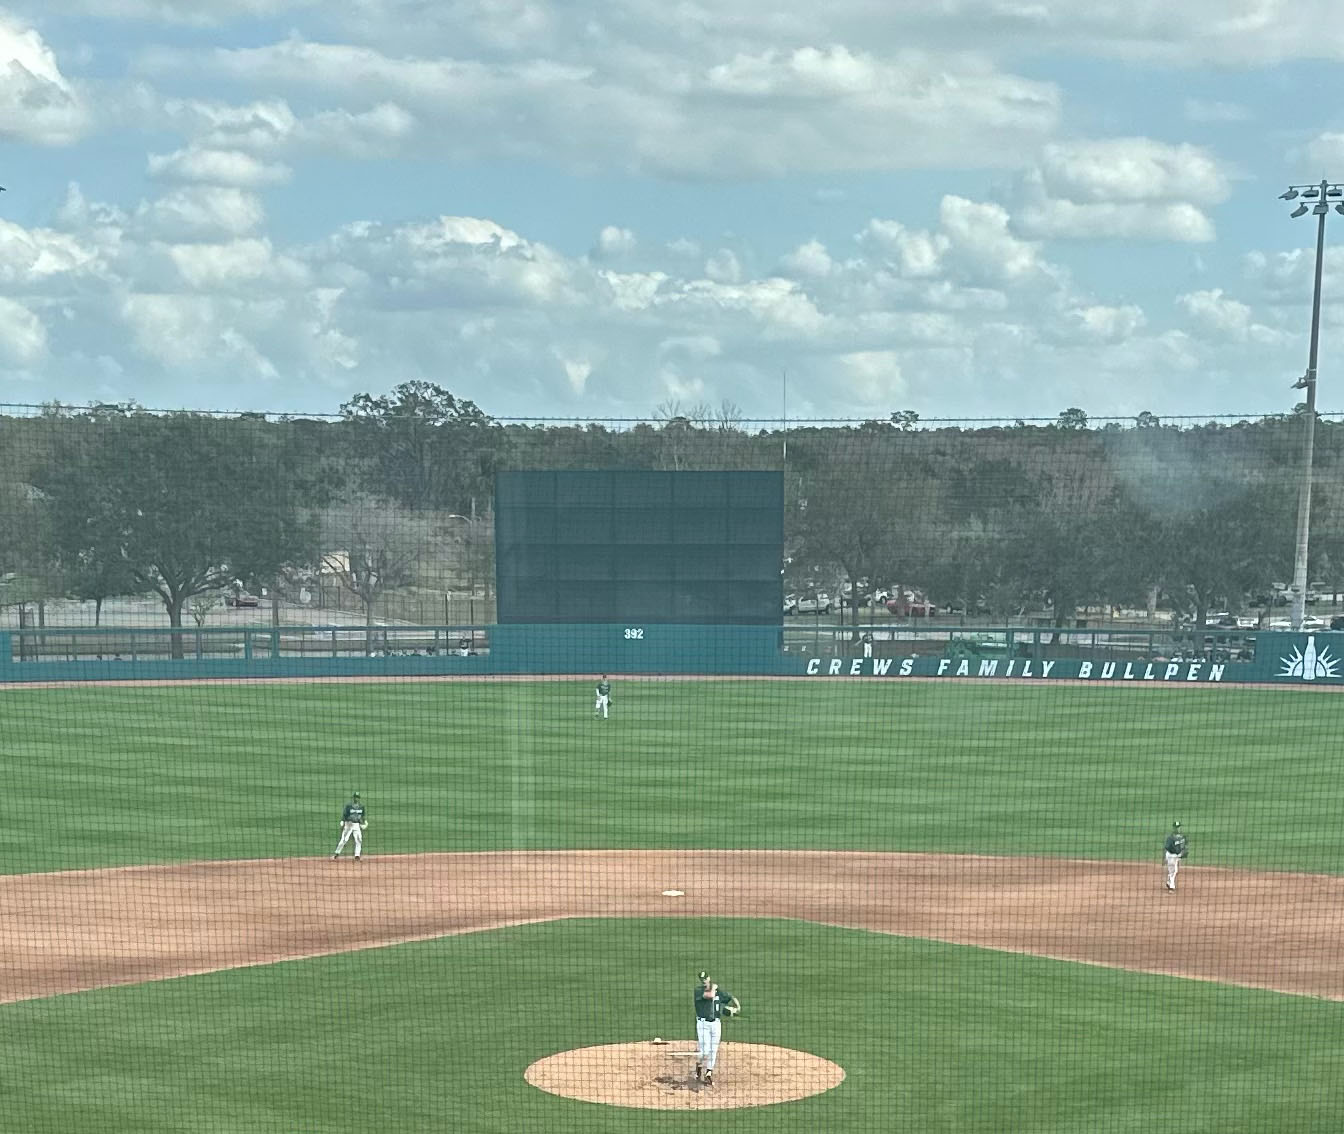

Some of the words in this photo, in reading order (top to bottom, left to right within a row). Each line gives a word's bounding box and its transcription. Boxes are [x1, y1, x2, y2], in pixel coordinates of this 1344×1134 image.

[623, 628, 644, 640] 392
[806, 658, 914, 676] CREWS
[937, 659, 1055, 677] FAMILY
[1078, 661, 1226, 681] BULLPEN
